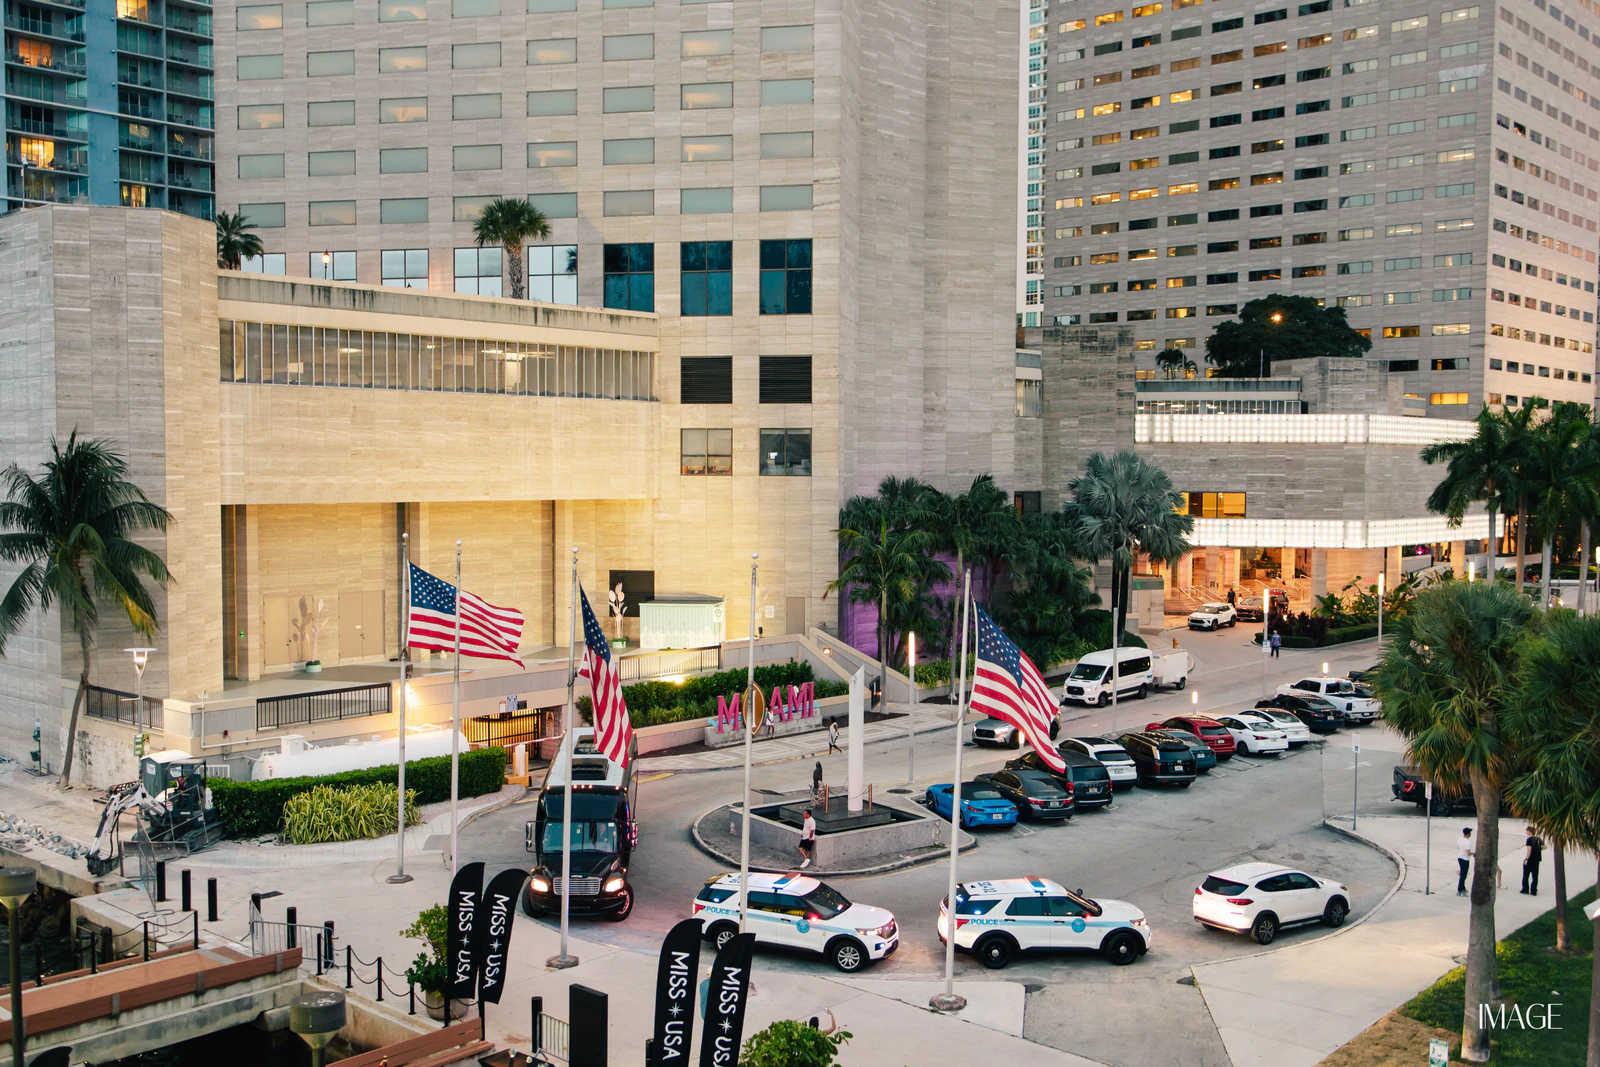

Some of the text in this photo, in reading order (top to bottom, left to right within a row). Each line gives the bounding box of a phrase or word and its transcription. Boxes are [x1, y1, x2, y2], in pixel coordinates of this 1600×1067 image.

[716, 681, 815, 734] MIAMI
[705, 905, 731, 916] POLICE
[970, 918, 999, 926] POLICE
[454, 891, 475, 984] MISS USA
[482, 894, 510, 988] MISS USA
[662, 951, 690, 1061] MISS USA
[718, 966, 742, 1014] MISS
